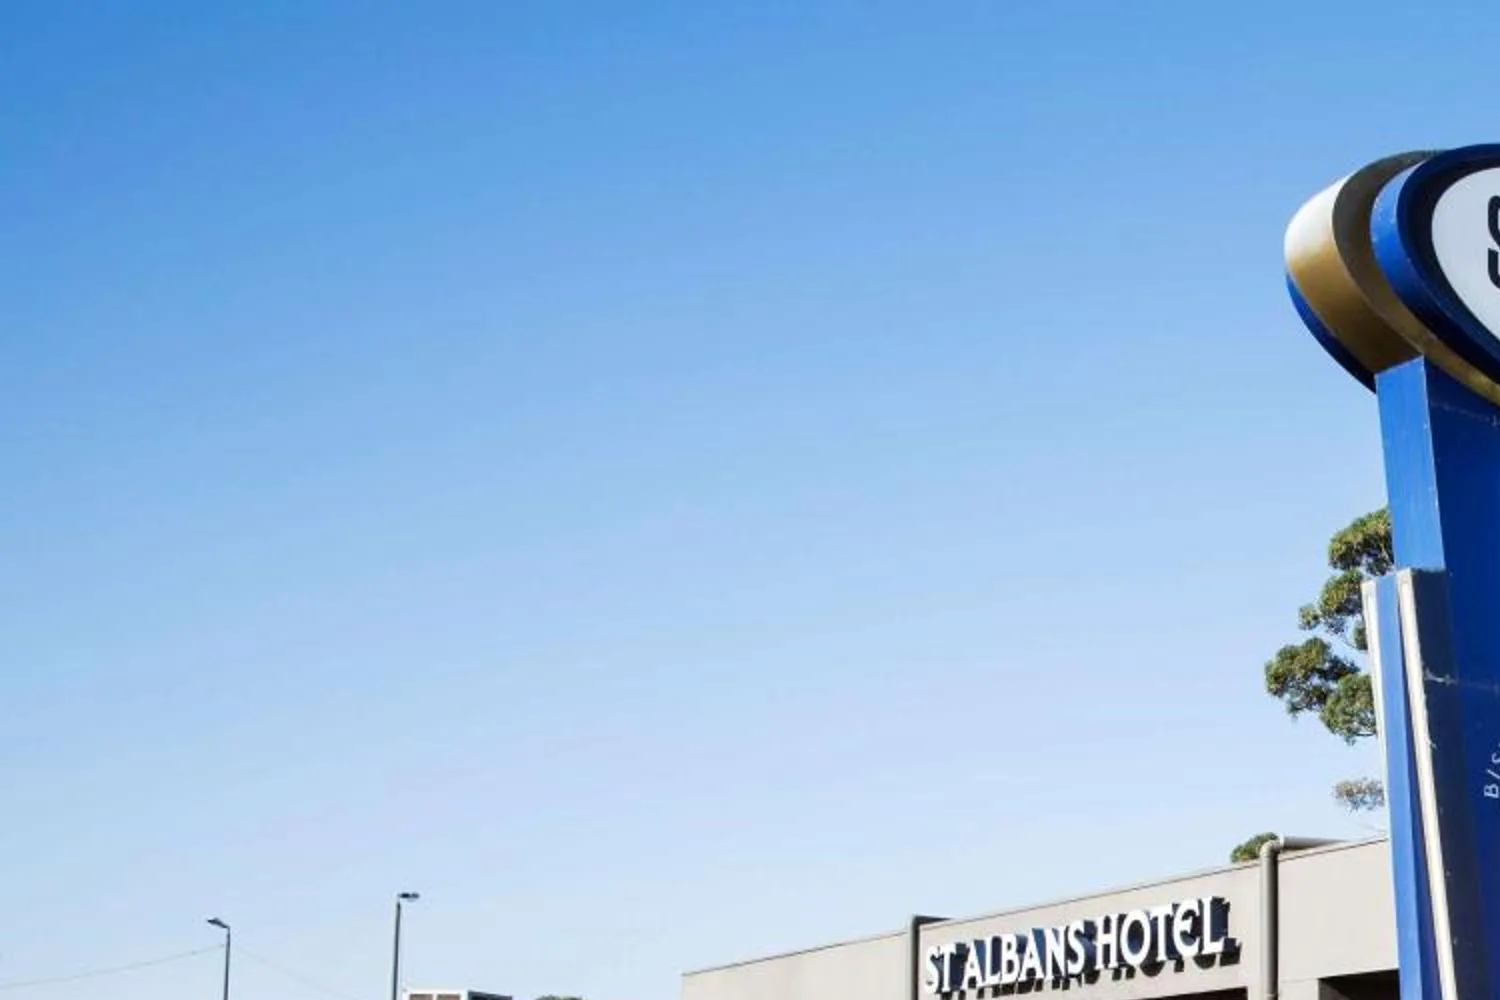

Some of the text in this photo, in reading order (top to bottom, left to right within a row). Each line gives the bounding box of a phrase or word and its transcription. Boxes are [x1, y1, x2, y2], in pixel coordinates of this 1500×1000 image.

[922, 896, 1225, 994] ST ALBANS HOTEL
